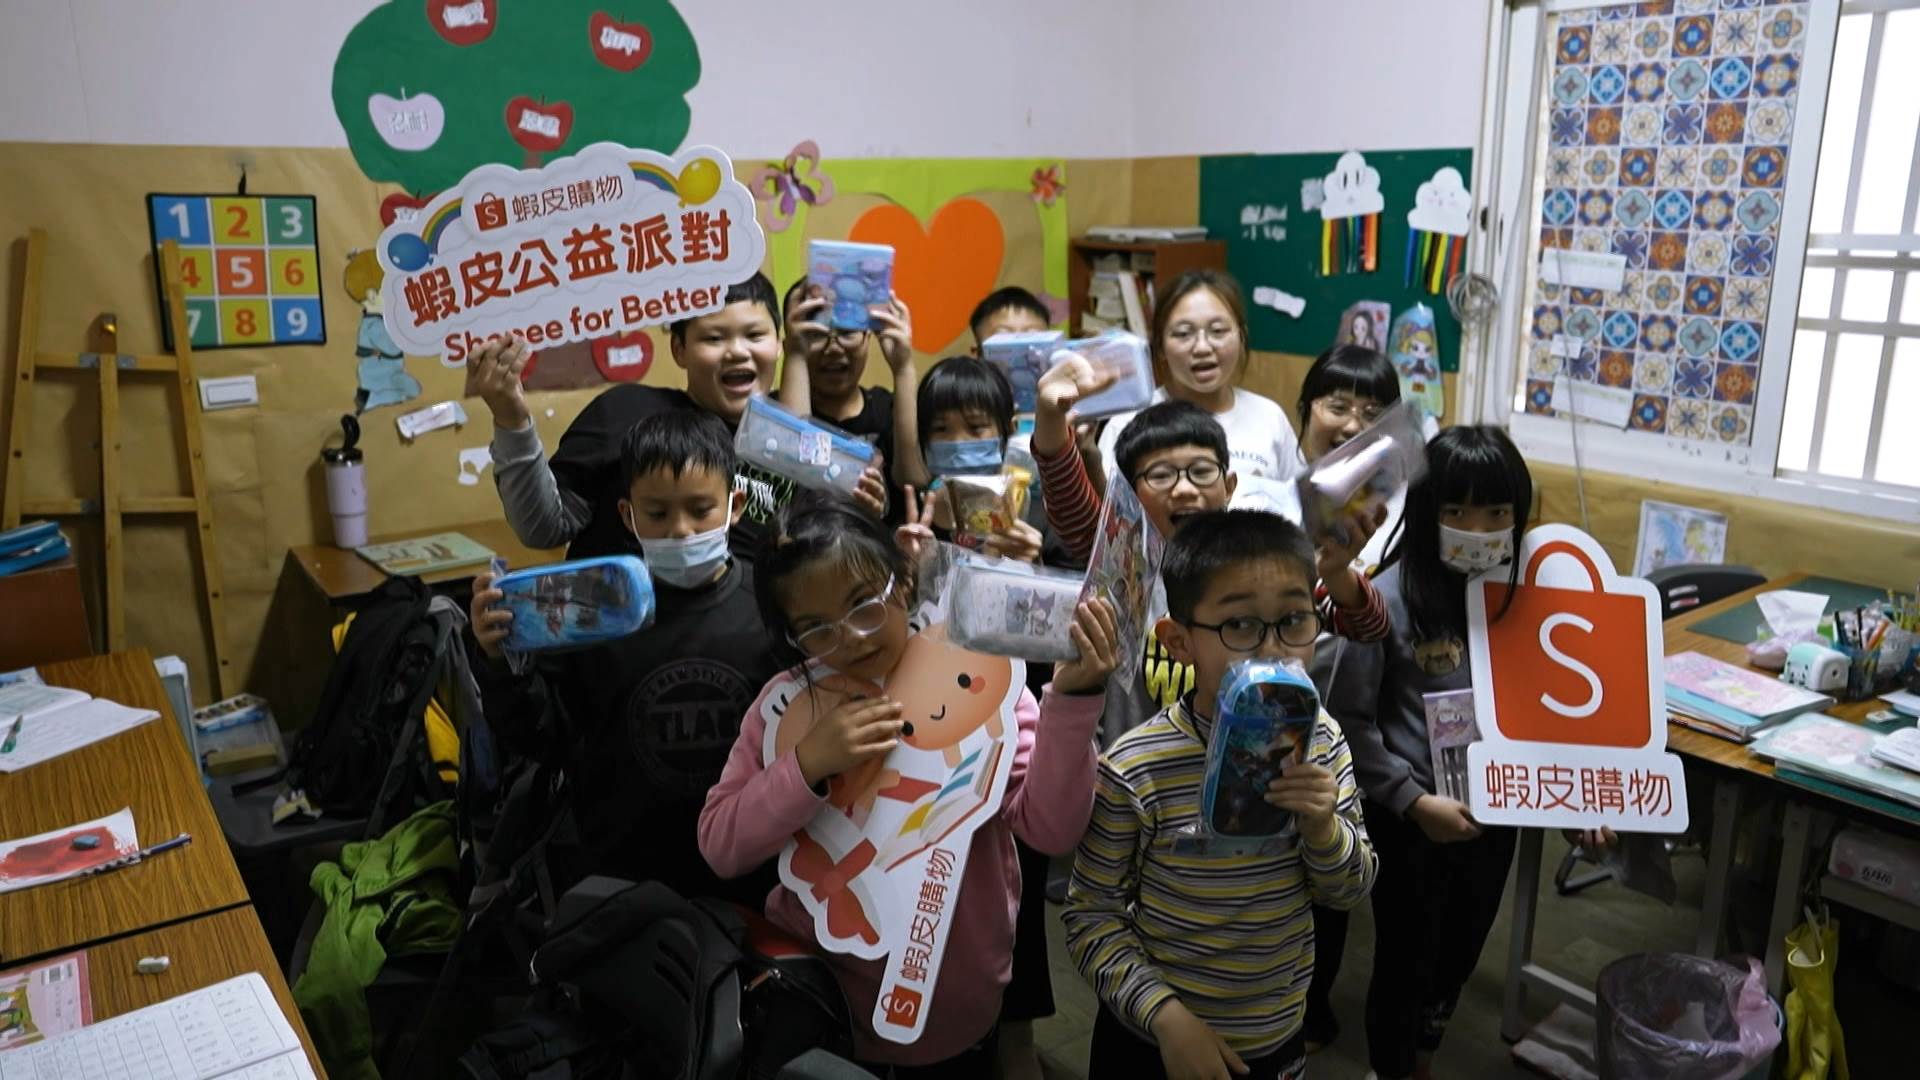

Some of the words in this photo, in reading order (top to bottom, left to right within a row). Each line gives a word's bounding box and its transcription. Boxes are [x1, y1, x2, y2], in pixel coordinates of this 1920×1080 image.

[168, 202, 191, 239] 1
[226, 205, 251, 238] 2
[280, 204, 304, 239] 3
[511, 174, 624, 223] 蝦皮購物
[181, 256, 201, 289] 4
[230, 255, 254, 289] 5
[284, 257, 305, 287] 6
[404, 209, 732, 328] 蝦皮公益派對
[186, 308, 201, 339] 7
[235, 308, 257, 337] 8
[287, 307, 308, 337] 9
[445, 319, 563, 362] Shee
[569, 306, 614, 336] for
[621, 285, 721, 325] Better
[1538, 611, 1604, 719] S
[1485, 760, 1673, 817] 蝦皮購物
[900, 847, 956, 985] 蝦皮購物
